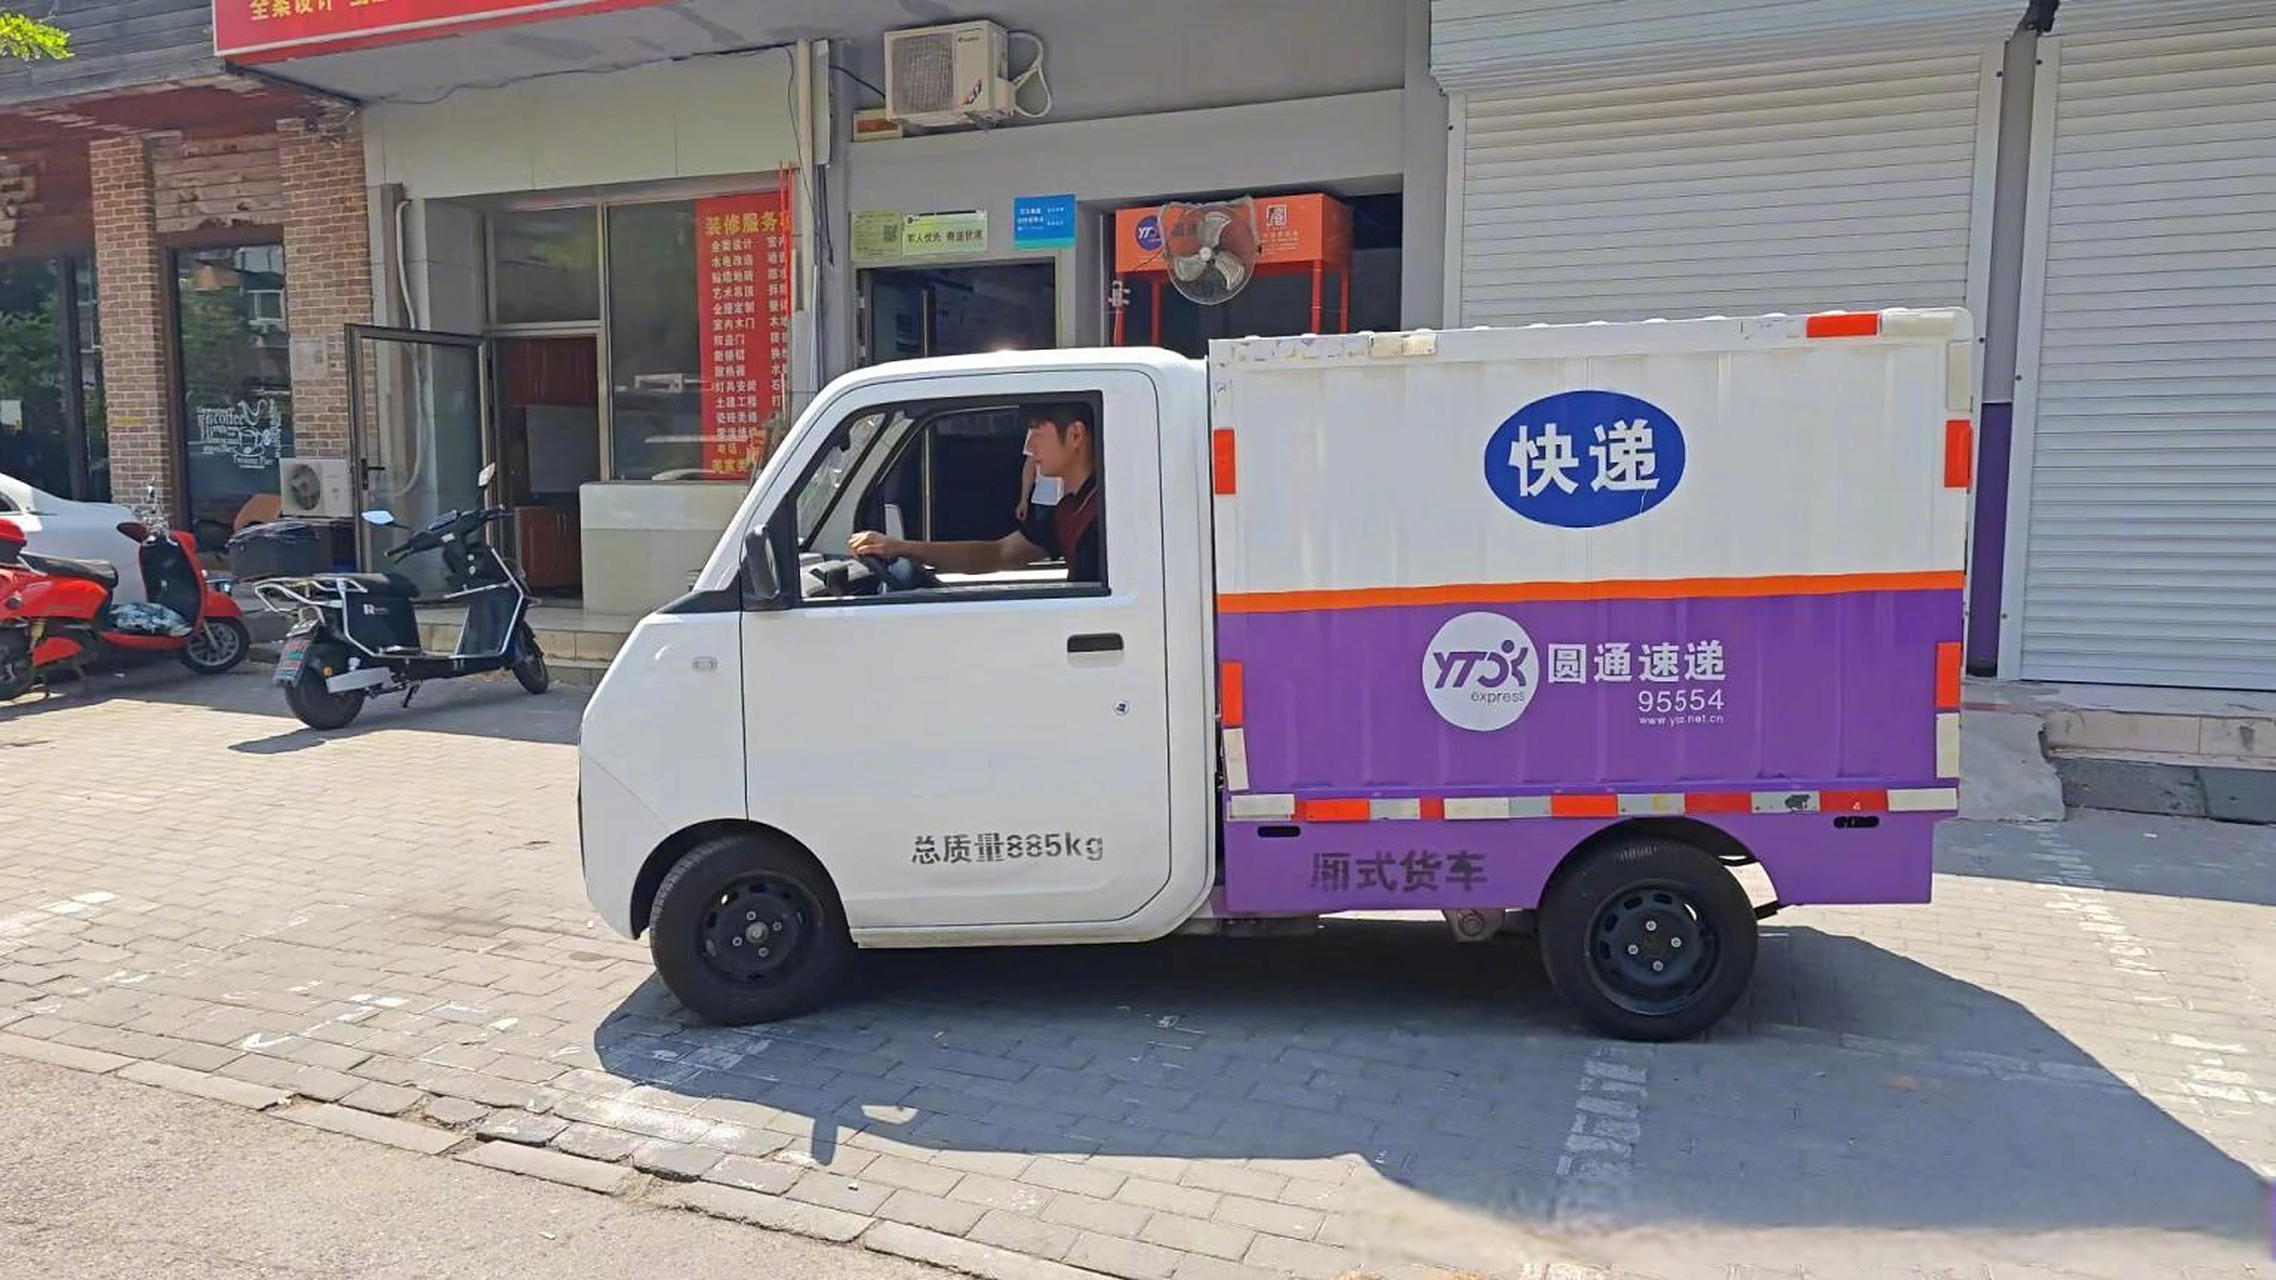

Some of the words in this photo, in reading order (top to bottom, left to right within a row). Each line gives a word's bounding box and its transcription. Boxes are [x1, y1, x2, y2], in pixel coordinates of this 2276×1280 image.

[1508, 419, 1660, 498] 快递
[1547, 640, 1726, 684] 圆通速递
[1470, 689, 1526, 704] express
[1637, 689, 1725, 713] 95554
[1310, 851, 1488, 893] 厢式货车
